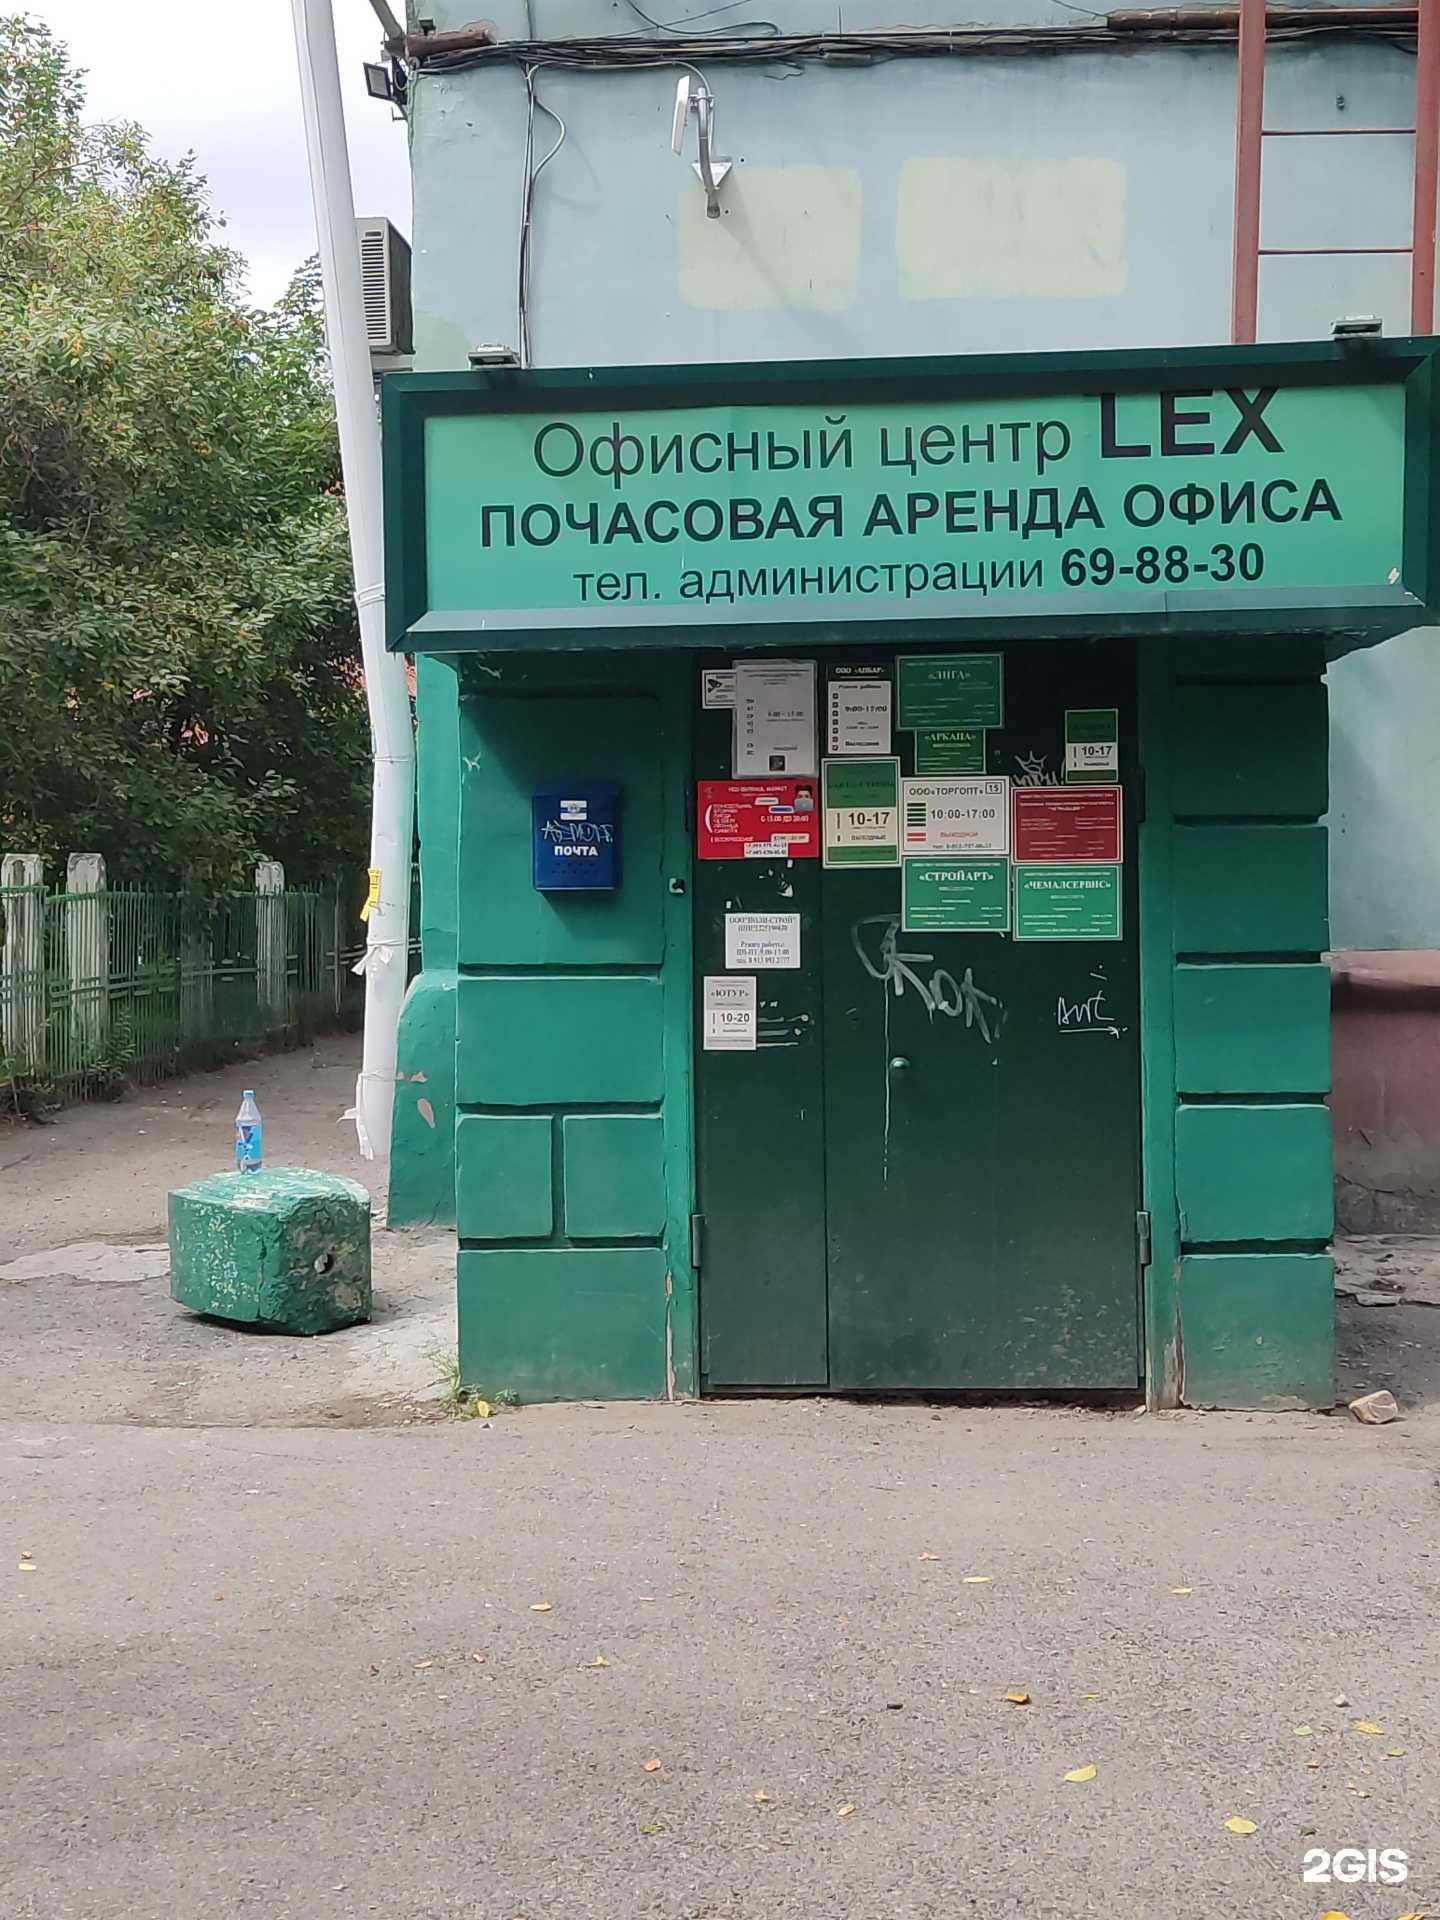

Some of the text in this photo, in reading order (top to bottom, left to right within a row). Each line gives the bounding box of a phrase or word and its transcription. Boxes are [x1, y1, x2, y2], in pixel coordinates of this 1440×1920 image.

[1099, 386, 1286, 459] LEX
[533, 414, 1072, 490] Офисный центр
[480, 477, 1344, 547] ПОЧАСОВАЯ АРЕНДА ОФИСА
[572, 541, 1265, 604] тел. администрации 69-88-30
[1081, 745, 1113, 756] 10-17
[988, 784, 1000, 792] 15
[848, 812, 890, 825] 10-17
[931, 809, 996, 819] 10:00-17:00
[554, 845, 599, 856] ПОЧТА
[721, 1013, 750, 1023] 10-20
